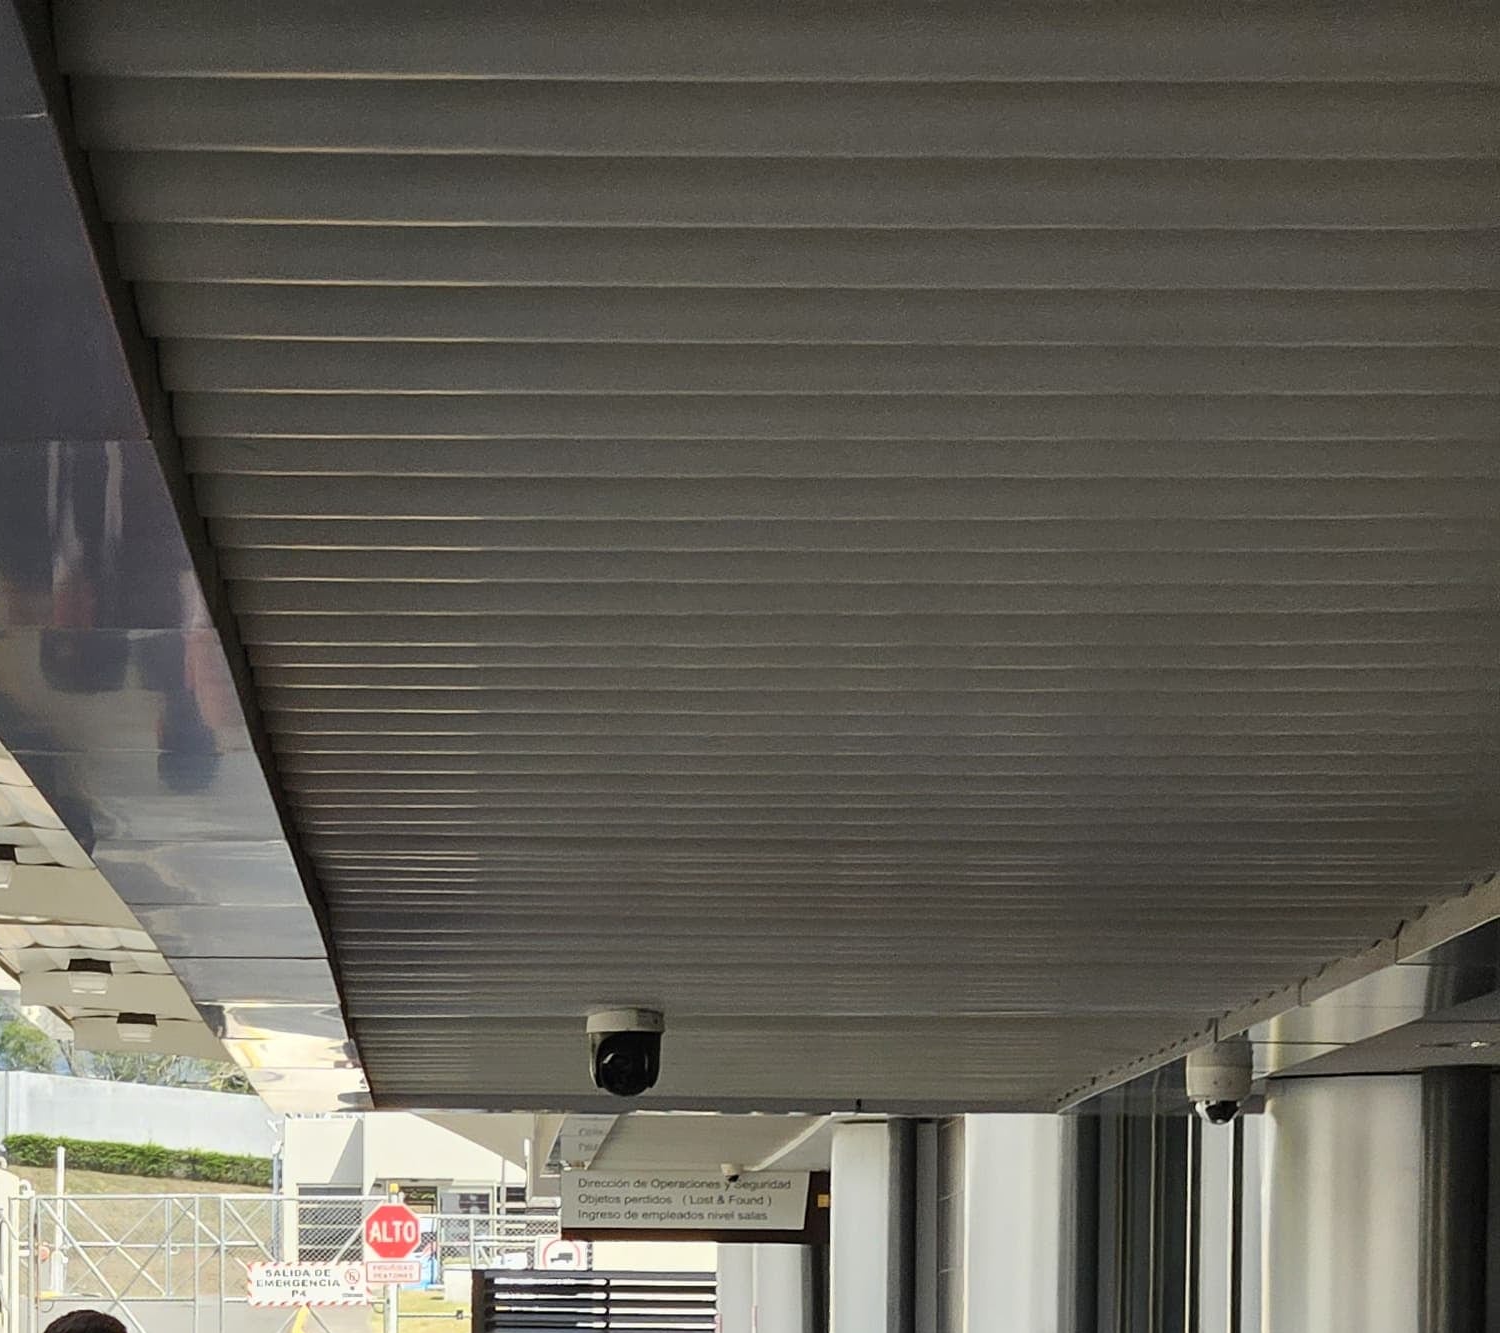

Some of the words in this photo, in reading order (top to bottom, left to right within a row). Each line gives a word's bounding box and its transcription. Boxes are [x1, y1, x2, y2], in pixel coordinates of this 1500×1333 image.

[578, 1178, 629, 1188] Dirección
[633, 1179, 647, 1188] de
[651, 1179, 720, 1191] Operaciones
[733, 1180, 791, 1192] Seguridad
[578, 1194, 621, 1206] Objetos
[624, 1195, 672, 1206] perdidos
[690, 1195, 713, 1205] Lost
[716, 1195, 725, 1205] &
[729, 1195, 764, 1205] Found
[578, 1210, 620, 1221] Ingreso
[624, 1210, 638, 1219] de
[642, 1210, 704, 1221] empleados
[368, 1220, 416, 1244] ALTO
[265, 1269, 310, 1278] SALIDA
[314, 1269, 331, 1278] DE
[256, 1279, 340, 1288] EMERGENCIA
